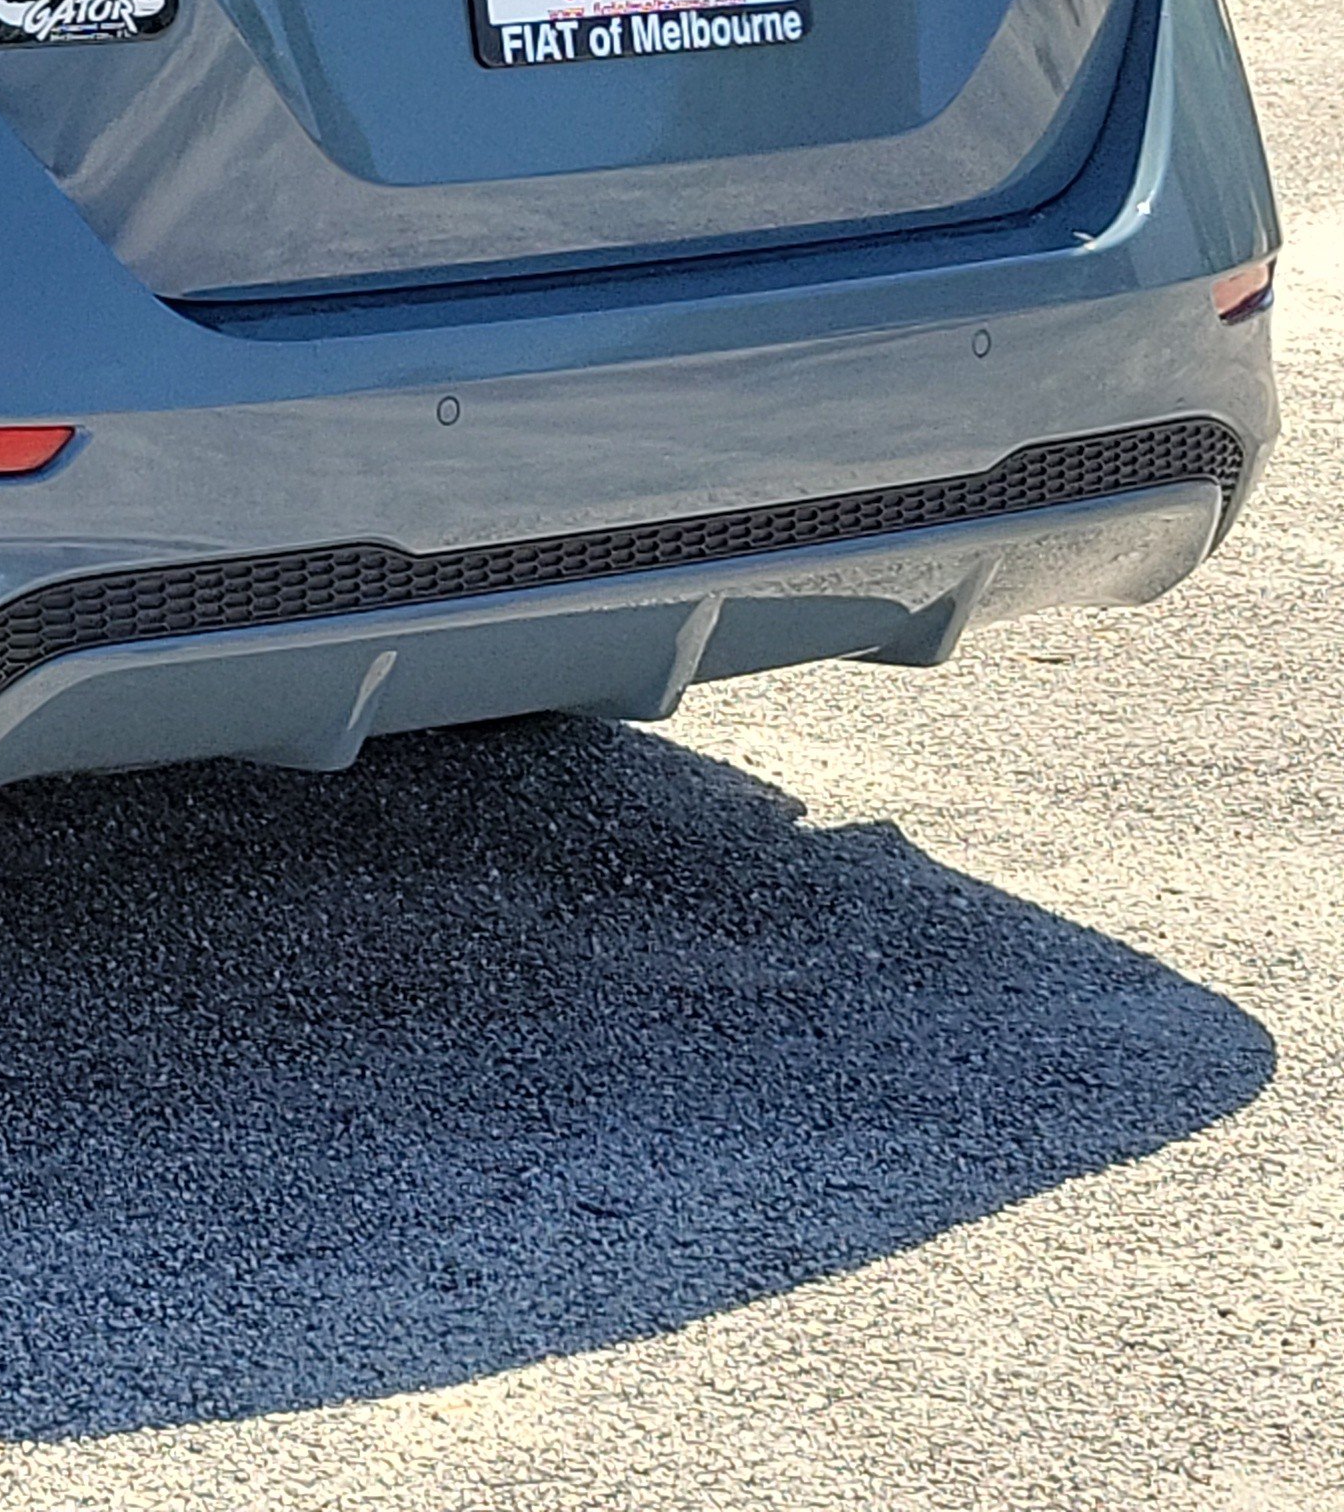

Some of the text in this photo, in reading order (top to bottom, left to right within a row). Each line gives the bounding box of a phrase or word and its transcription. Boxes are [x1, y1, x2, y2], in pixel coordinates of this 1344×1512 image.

[501, 9, 803, 64] FIAT of Melbourne
